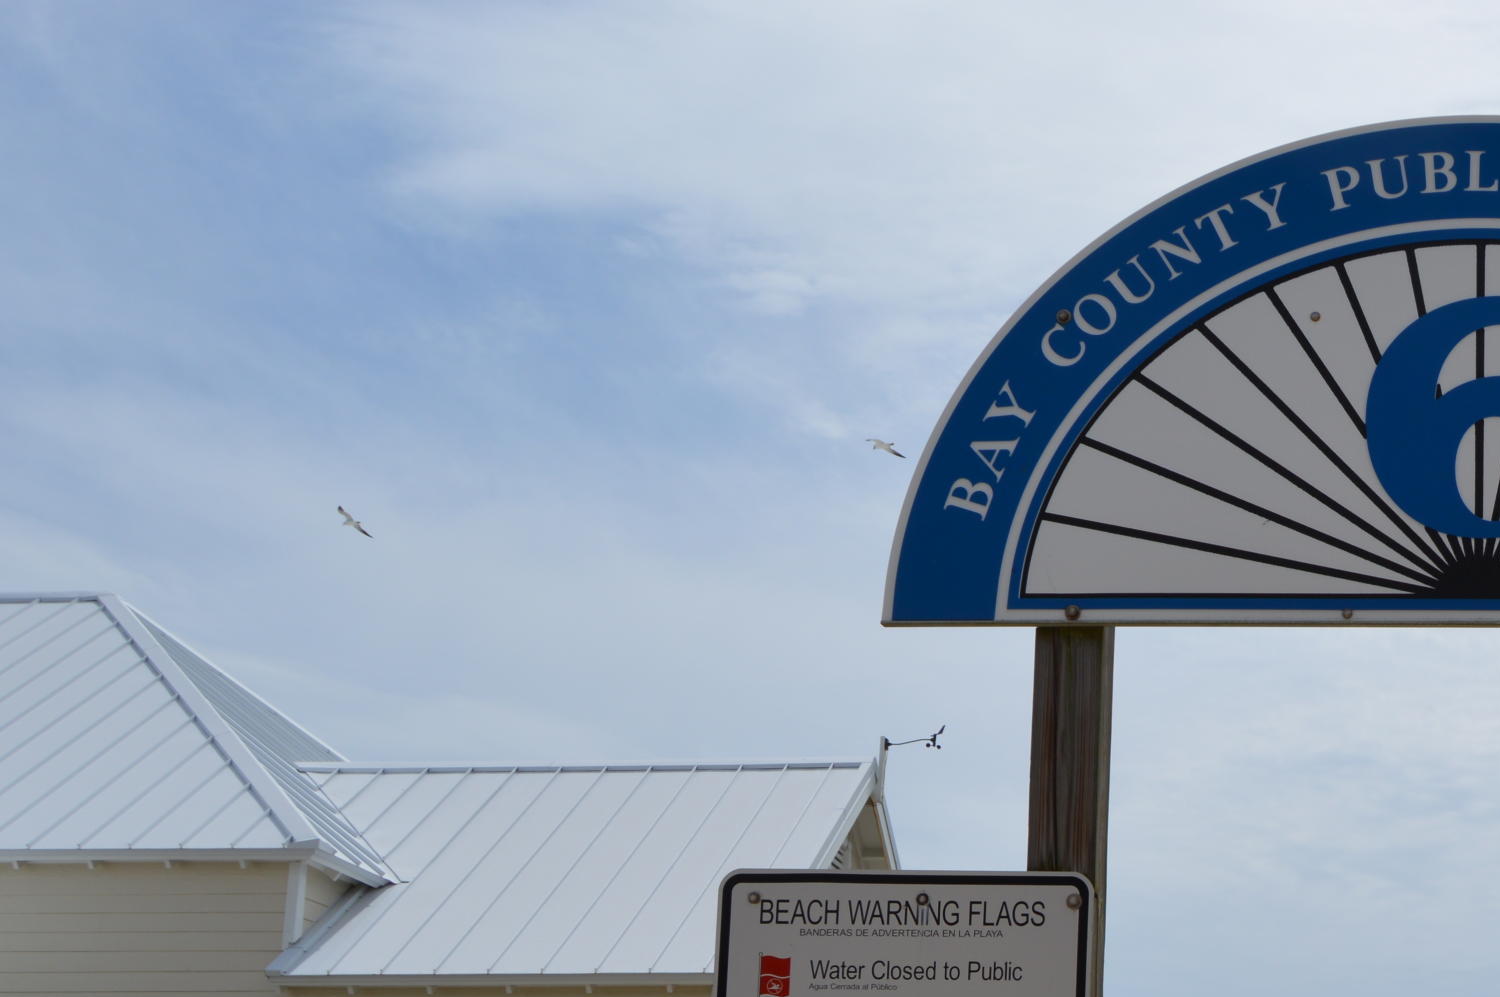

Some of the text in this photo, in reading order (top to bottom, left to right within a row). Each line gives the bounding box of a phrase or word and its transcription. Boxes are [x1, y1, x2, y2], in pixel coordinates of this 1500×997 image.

[943, 381, 1037, 521] BAY
[1041, 183, 1286, 369] COUNTY
[759, 899, 1046, 927] BEACH WARNING FLAGS
[798, 927, 1003, 938] BANDERAS DE ADVERTENCIA EN LA PLAYA
[809, 959, 1023, 981] Water Closed to Public
